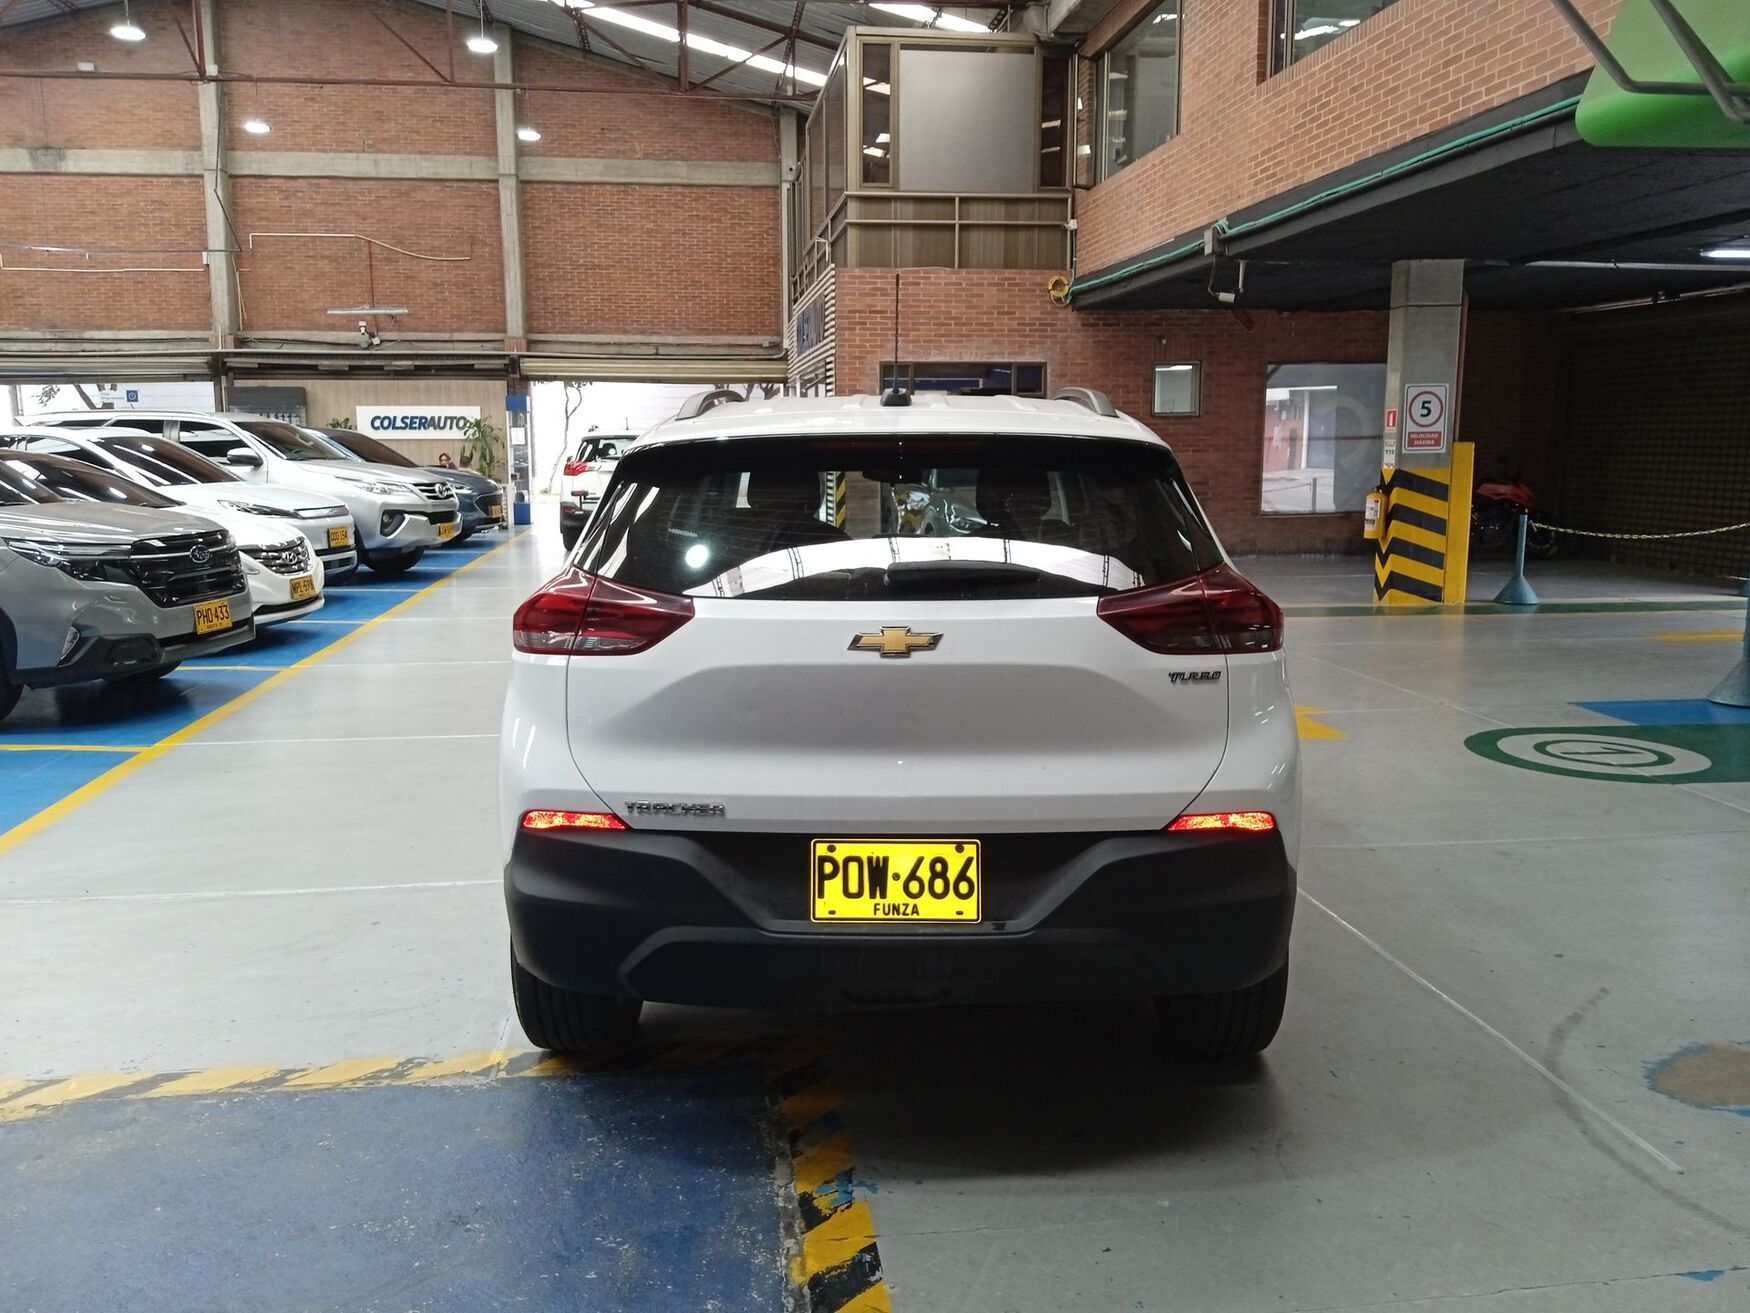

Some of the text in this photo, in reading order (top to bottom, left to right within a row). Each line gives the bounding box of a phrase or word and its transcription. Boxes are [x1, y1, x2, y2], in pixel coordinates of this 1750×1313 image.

[1420, 400, 1432, 418] 5
[370, 415, 469, 431] COLSERAUTO
[1168, 671, 1222, 683] TURBO
[624, 800, 726, 816] TRACKER
[873, 903, 920, 916] FUNZA
